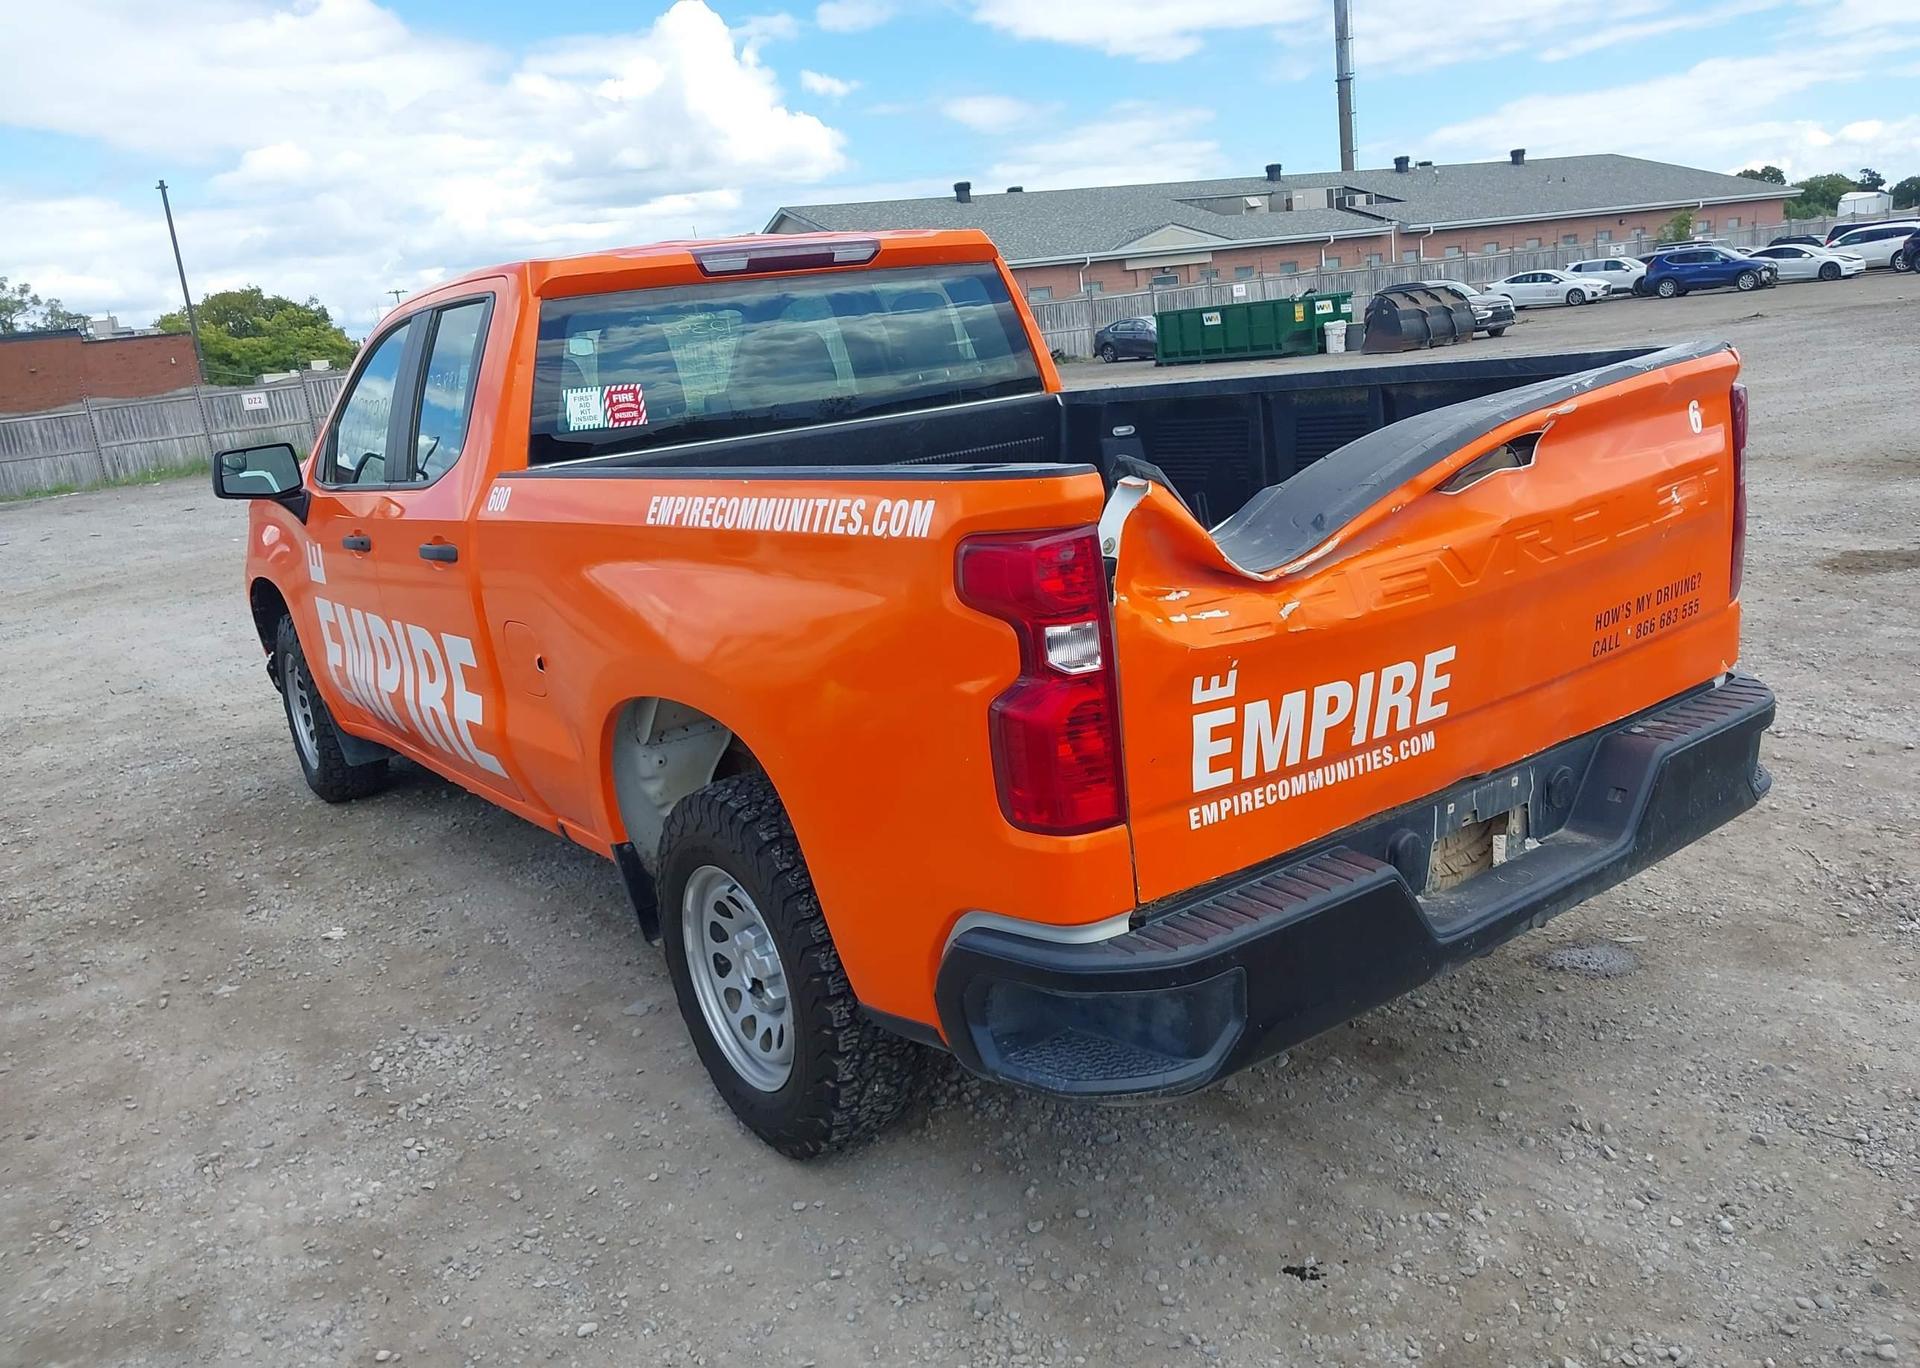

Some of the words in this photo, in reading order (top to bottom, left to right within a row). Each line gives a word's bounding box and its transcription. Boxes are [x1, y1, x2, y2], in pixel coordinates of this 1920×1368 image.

[612, 393, 635, 403] FIRE
[1688, 399, 1702, 434] 6
[487, 486, 512, 512] 600
[645, 495, 936, 538] EMPIRECOMMUNITIES.COM
[1592, 632, 1621, 658] CALL
[1635, 617, 1656, 640] 866
[1659, 607, 1678, 629] 683
[1681, 598, 1699, 620] 555
[1595, 601, 1632, 632] HOW'S
[1635, 592, 1652, 615] MY
[1655, 572, 1702, 606] DRIVING?
[315, 596, 509, 779] EMPIRE
[1192, 645, 1457, 794] EMPIRE
[1188, 730, 1436, 831] EMPIRECOMMUNITIES.COM
